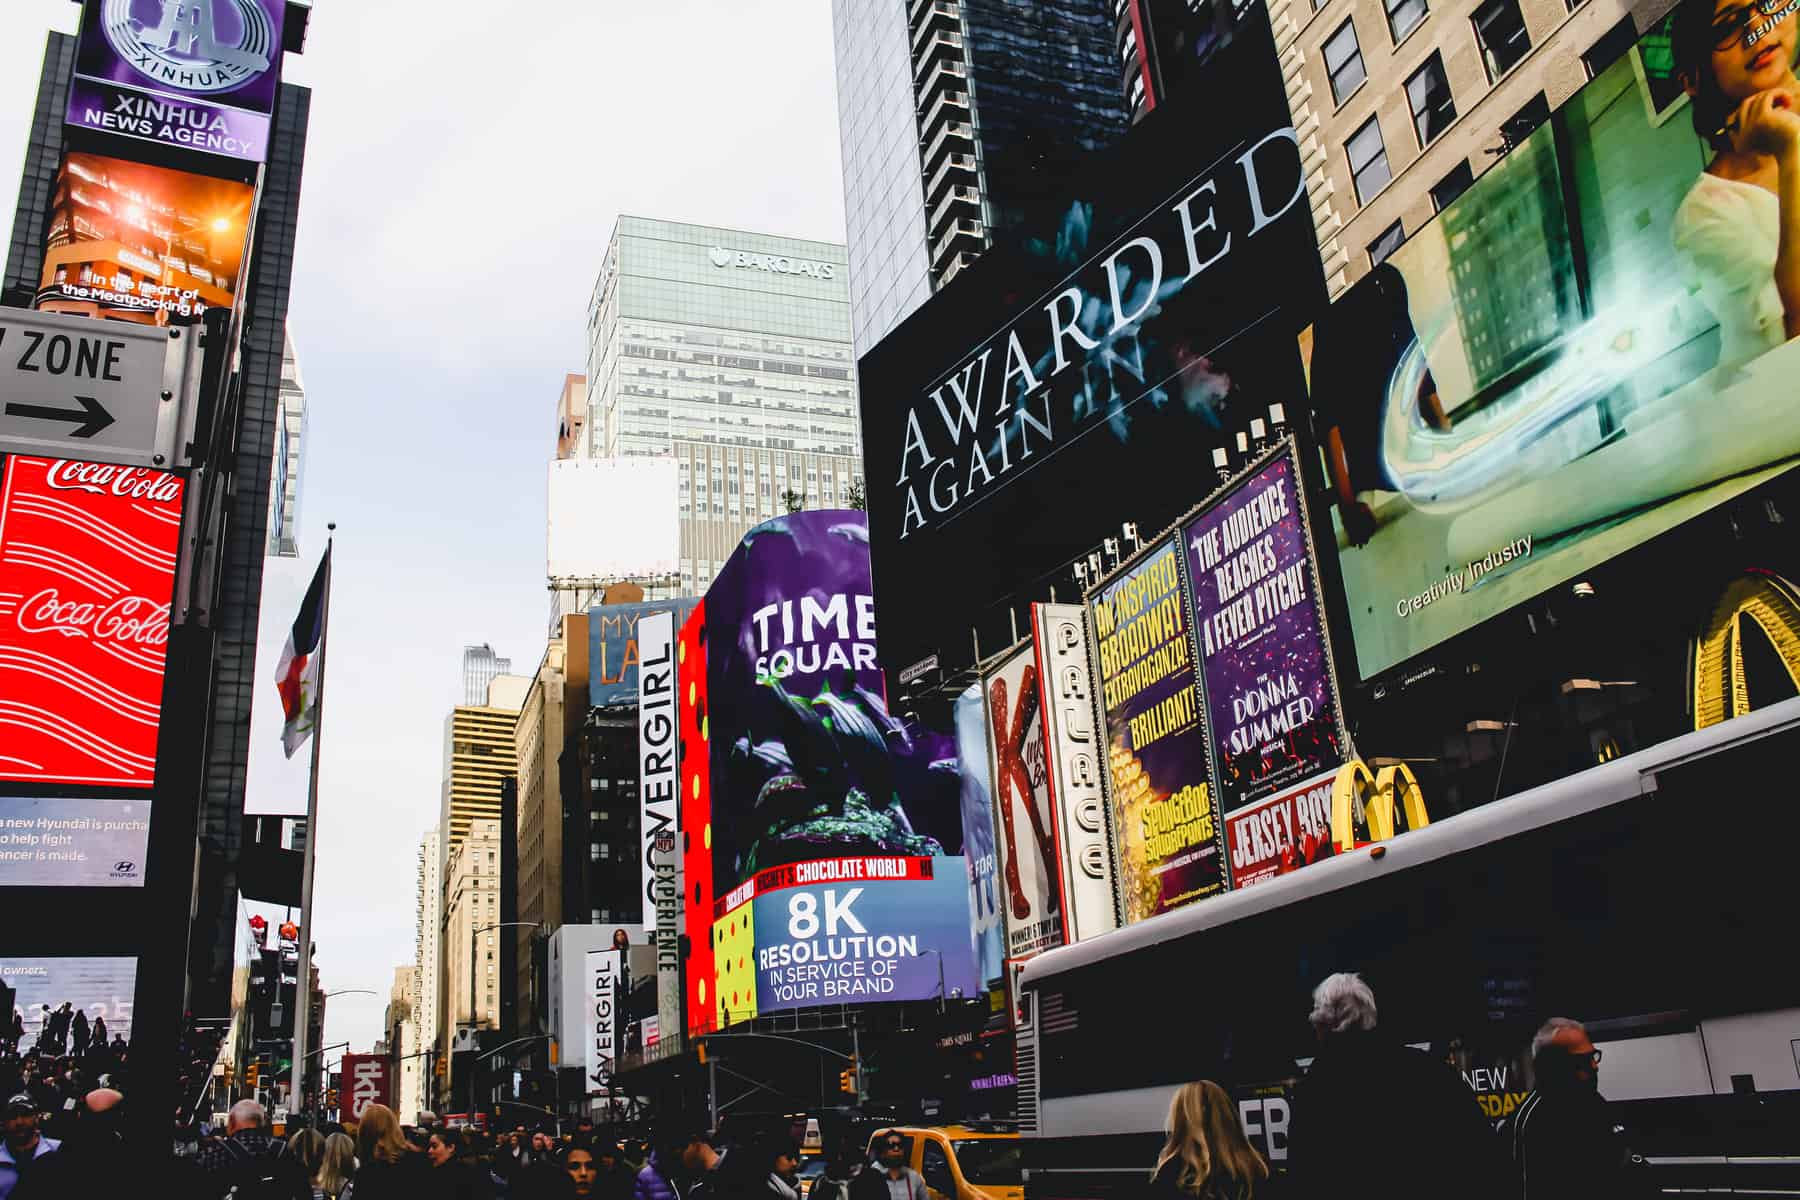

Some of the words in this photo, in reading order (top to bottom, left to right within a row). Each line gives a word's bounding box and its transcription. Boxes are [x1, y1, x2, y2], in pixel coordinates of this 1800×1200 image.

[136, 53, 229, 86] XINHUA
[85, 108, 152, 134] NEWS
[158, 124, 251, 154] AGENCY
[115, 94, 229, 133] XINHUA
[735, 252, 834, 279] BARCLAYS
[62, 284, 88, 297] the
[91, 288, 190, 316] Meatpacking
[183, 287, 199, 300] of
[896, 126, 1307, 486] AWARDED
[16, 331, 125, 381] ZONE
[47, 460, 178, 501] Coca-Cola
[900, 387, 1054, 539] AGAIN
[1222, 478, 1290, 557] AUDIENCE
[1115, 552, 1179, 624] INSPIRED
[1214, 533, 1277, 604] REACHES
[1397, 571, 1464, 617] Creativity
[1468, 534, 1533, 580] Industry
[17, 588, 171, 644] Coca-Cola
[601, 611, 640, 642] MY
[753, 594, 877, 652] TIME
[1100, 590, 1183, 680] BROADWAY
[1203, 617, 1215, 657] A
[1213, 593, 1257, 650] FEVER
[754, 642, 877, 685] SQUAR
[1104, 633, 1190, 709] EXTRAVAGANZA!
[1233, 671, 1299, 725] DONNA
[1231, 696, 1314, 755] SUMMER
[1057, 622, 1104, 880] PALACE
[6, 819, 34, 828] new
[37, 818, 90, 831] Hyundai
[92, 819, 101, 830] is
[11, 833, 39, 846] help
[42, 833, 72, 847] fight
[1233, 799, 1294, 869] JERSEY
[35, 849, 46, 861] is
[796, 858, 864, 882] CHOCOLATE
[864, 858, 907, 877] WORLD
[656, 864, 678, 972] EXPERIENCE
[788, 888, 868, 939] 8K
[759, 935, 918, 970] RESOLUTION
[770, 969, 783, 986] IN
[786, 961, 865, 982] SERVICE
[871, 960, 898, 976] OF
[774, 982, 818, 1003] YOUR
[824, 977, 894, 997] BRAND
[353, 1060, 383, 1119] tkts
[1462, 1066, 1507, 1092] NEW
